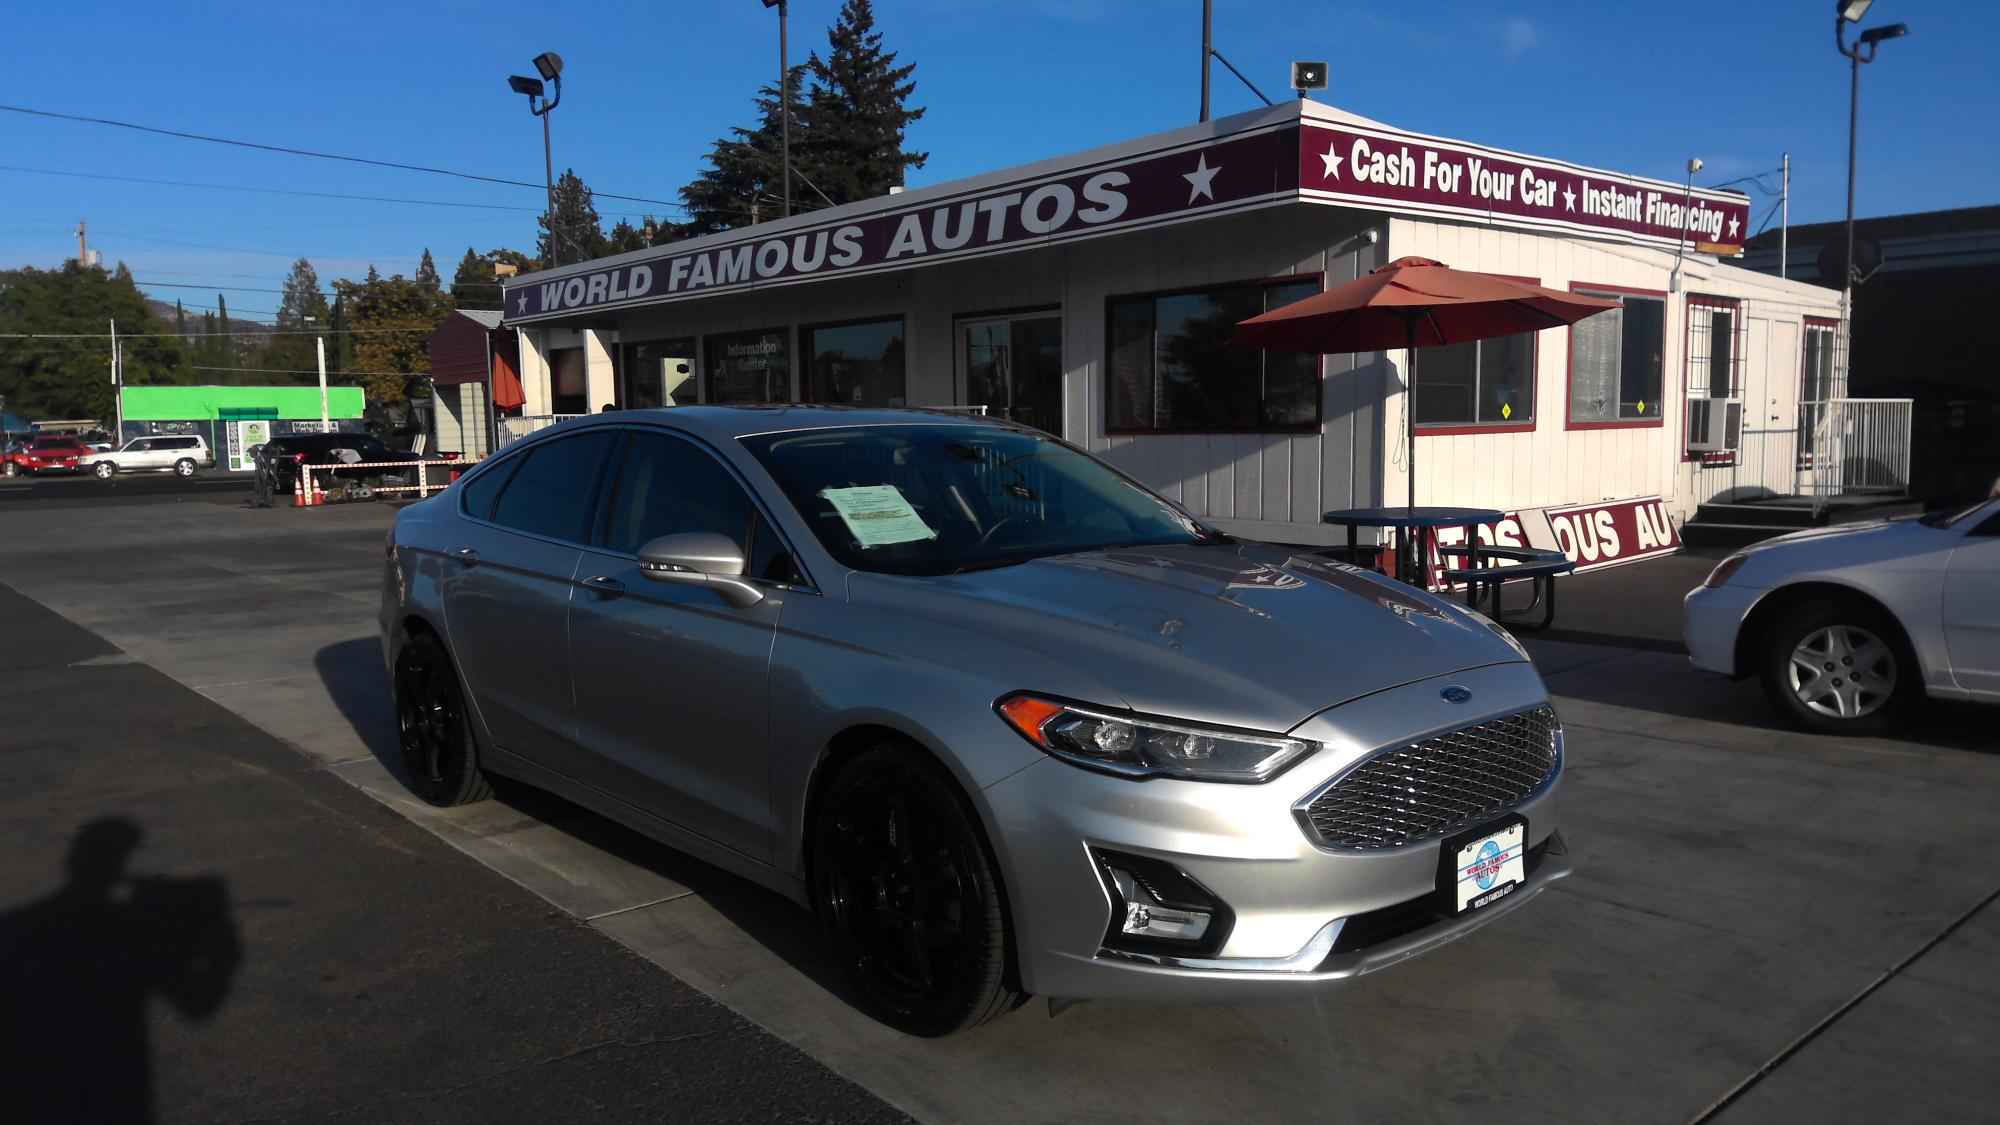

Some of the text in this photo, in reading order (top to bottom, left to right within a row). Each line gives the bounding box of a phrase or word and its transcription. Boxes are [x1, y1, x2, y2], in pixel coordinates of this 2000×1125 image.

[1351, 138, 1557, 208] Cash For Your Car
[1583, 179, 1724, 242] Instant Financing
[539, 171, 1131, 312] WORLD FAMOUS AUTOS
[728, 341, 776, 357] Information
[1635, 501, 1673, 551] AU
[1466, 862, 1487, 875] WORLD
[1475, 864, 1500, 880] AUTOS
[1474, 883, 1514, 909] WORLD FAMOUS AUTO
